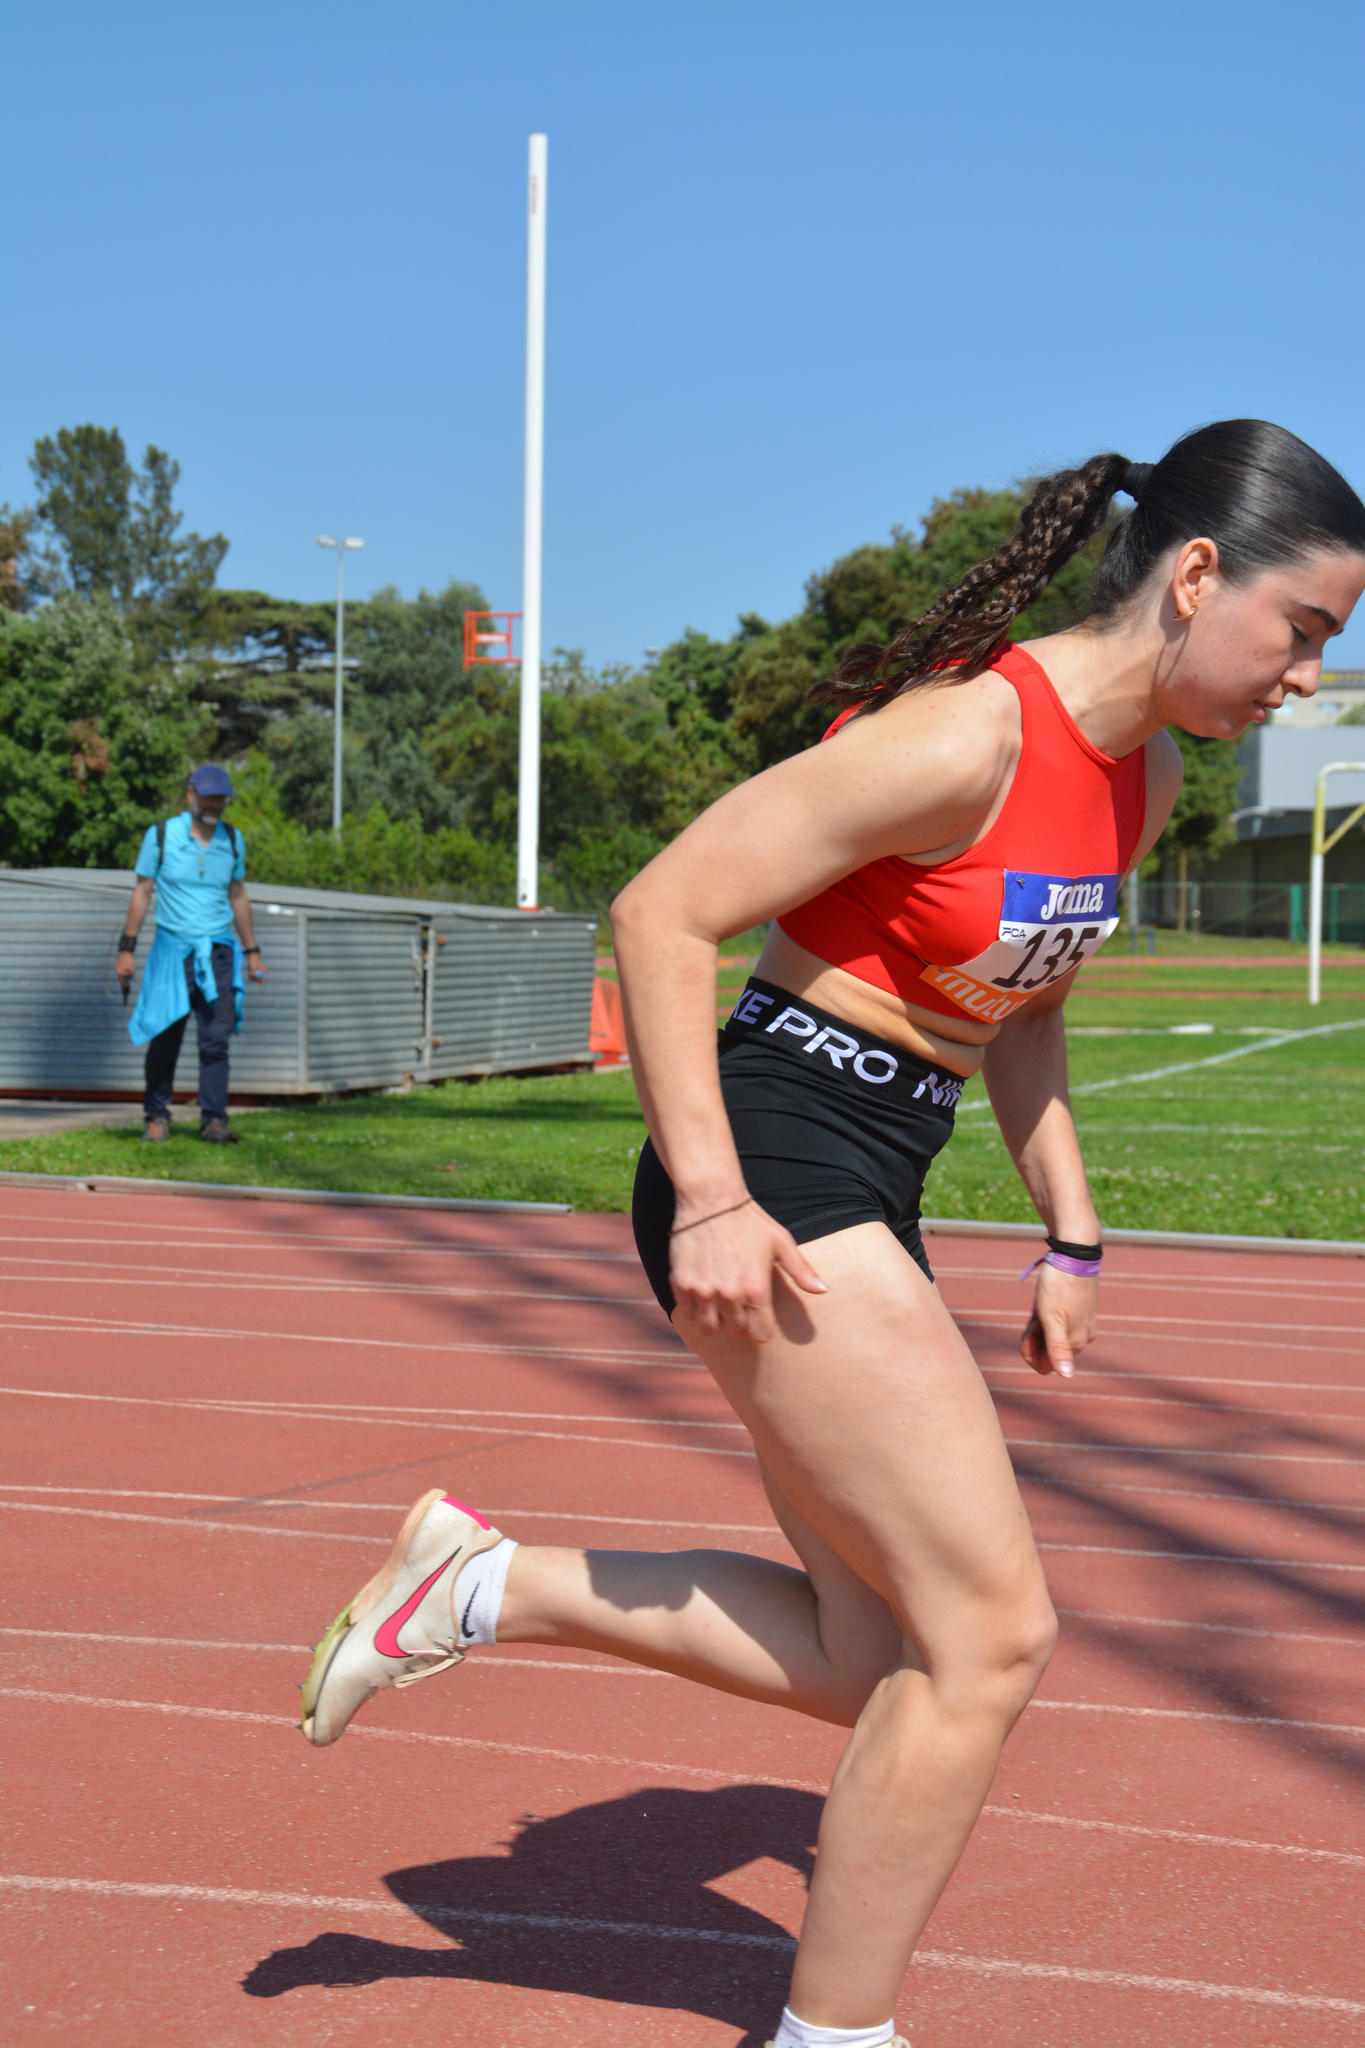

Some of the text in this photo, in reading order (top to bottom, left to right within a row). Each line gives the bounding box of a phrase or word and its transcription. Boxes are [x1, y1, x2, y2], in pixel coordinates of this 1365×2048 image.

[1040, 883, 1104, 920] Joma
[1001, 926, 1026, 938] FCA
[991, 927, 1100, 990] 135
[765, 1006, 899, 1084] PRO
